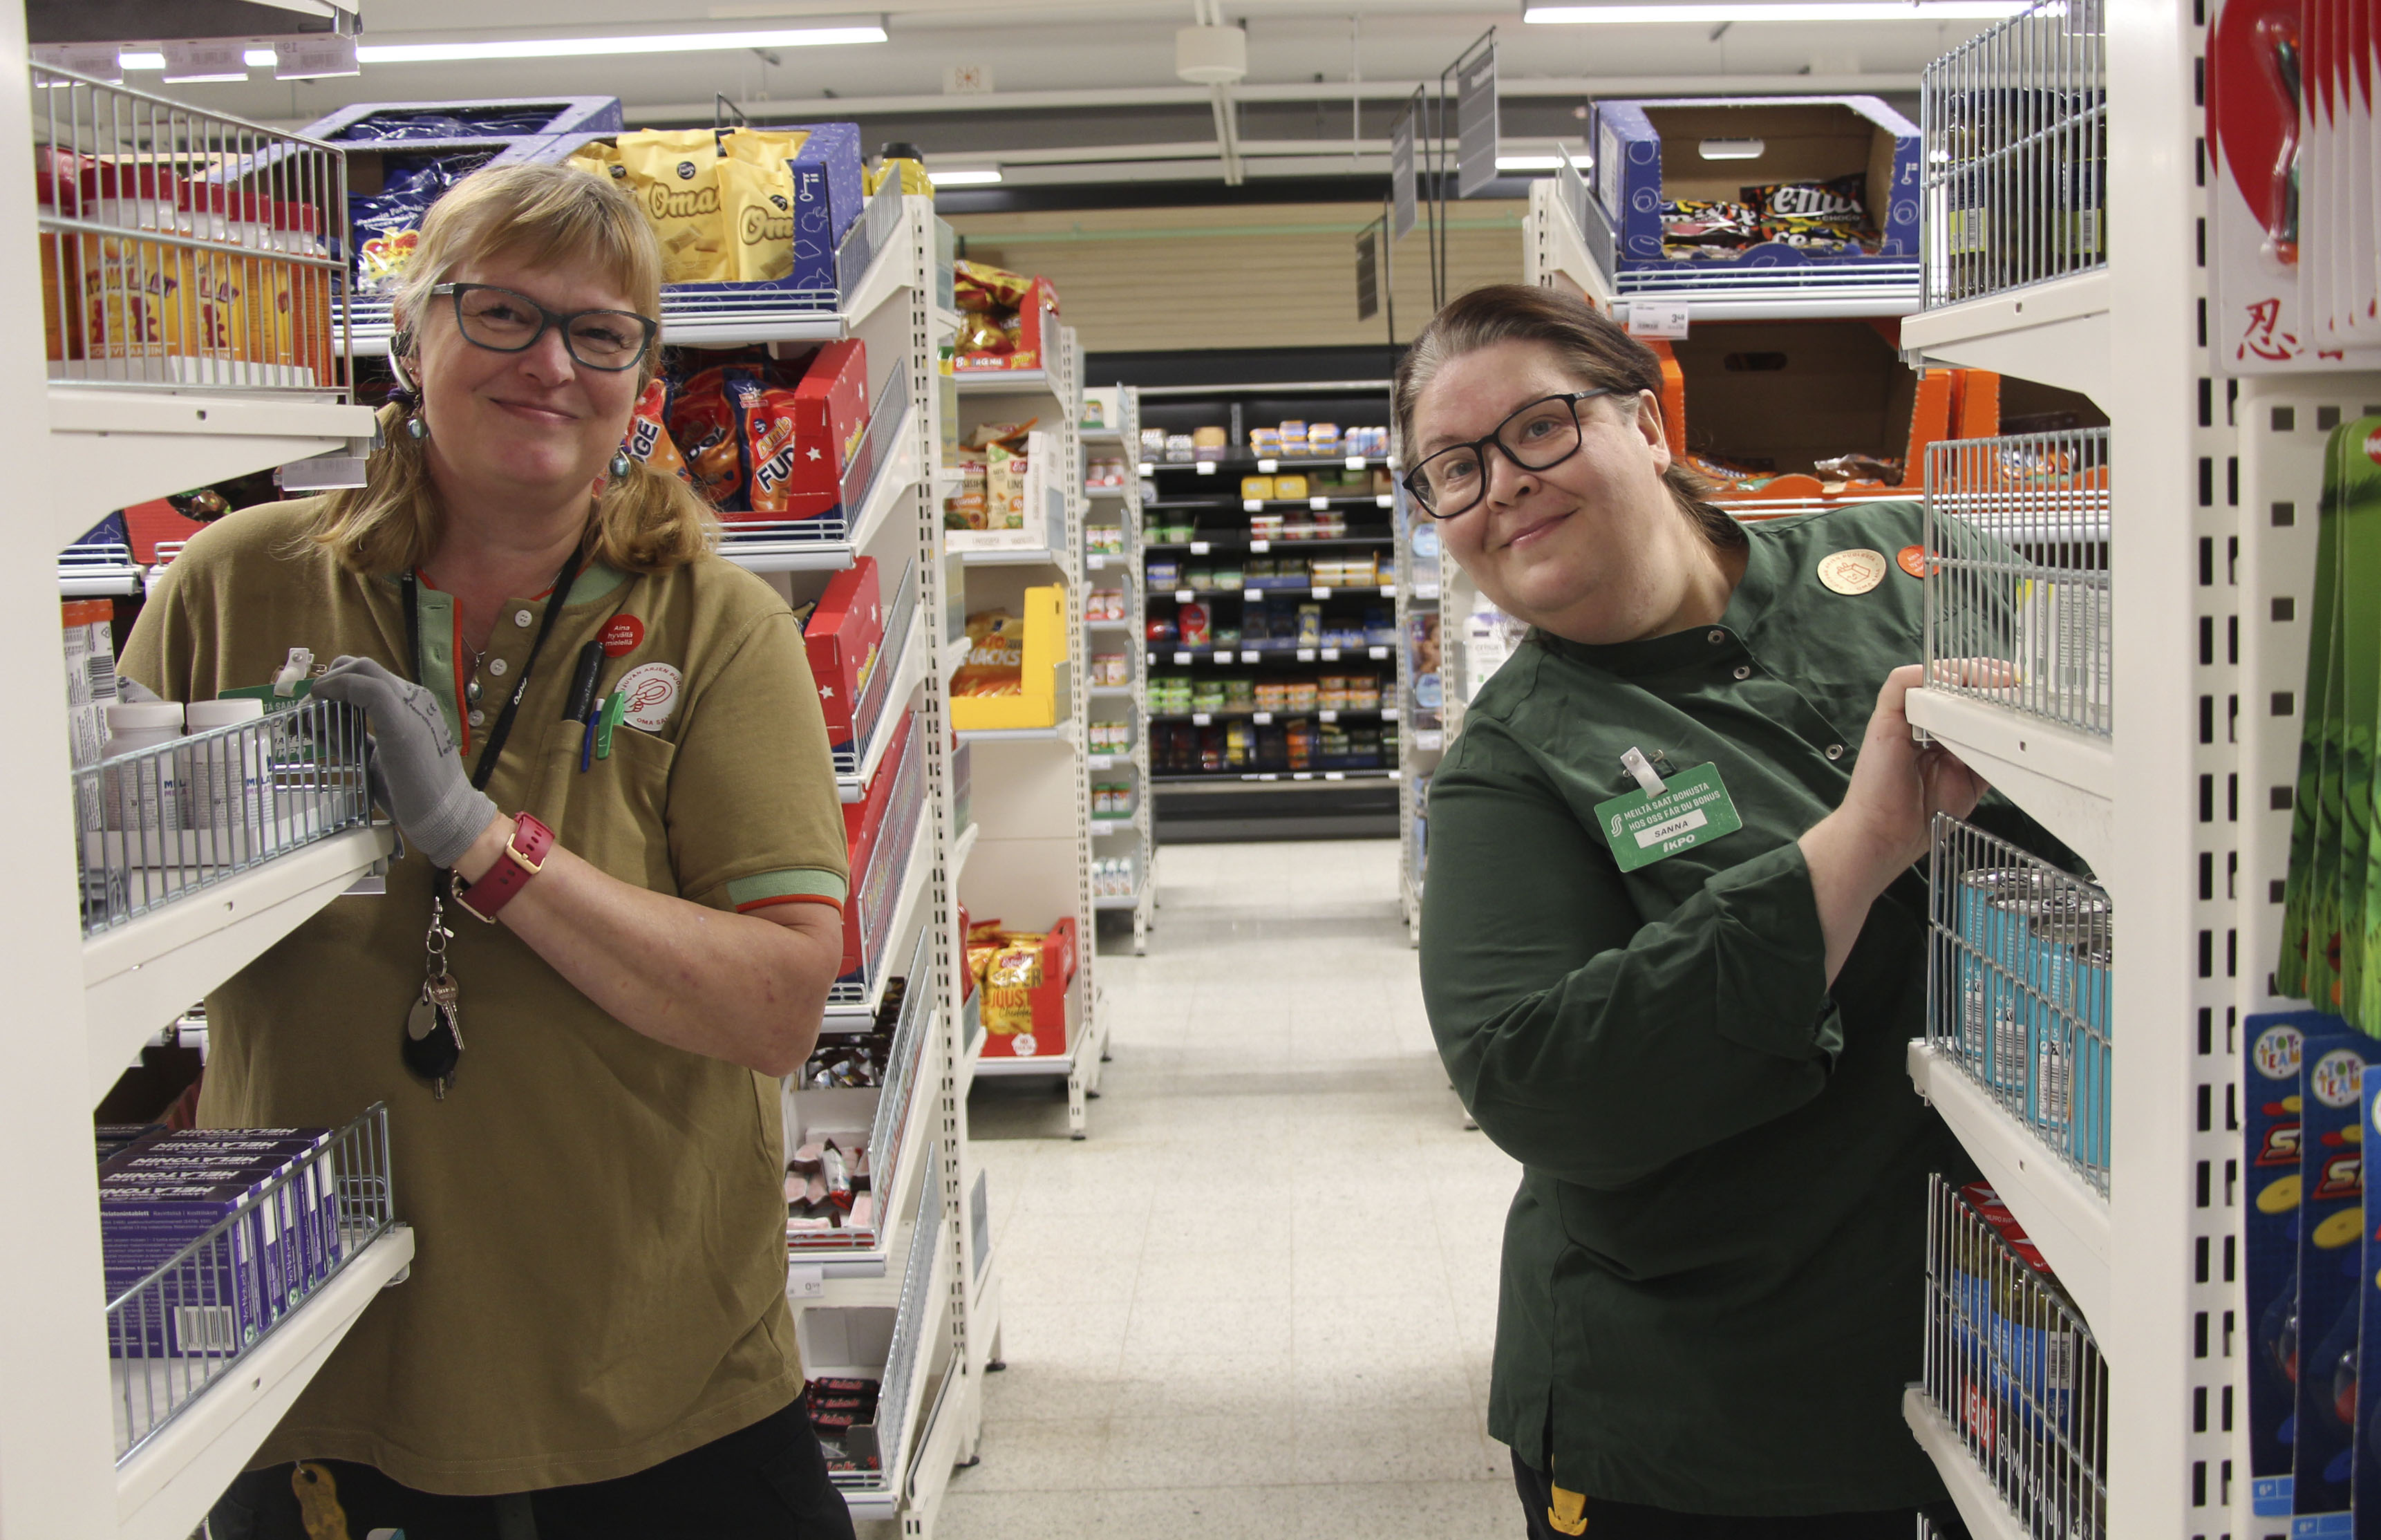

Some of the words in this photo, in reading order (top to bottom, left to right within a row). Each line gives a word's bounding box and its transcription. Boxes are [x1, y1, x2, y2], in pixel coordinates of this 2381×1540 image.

[2244, 298, 2297, 360] 忍
[608, 631, 633, 640] hyvällä
[275, 699, 296, 711] SAAT
[1624, 803, 1653, 820] MEILTÄ
[1652, 796, 1672, 811] SAAT
[1673, 782, 1710, 802] BONUSTA
[1628, 819, 1646, 832] HOS
[1646, 814, 1664, 827] OSS
[1664, 805, 1681, 820] FÅR
[1681, 802, 1693, 813] DU
[1693, 790, 1721, 807] BONUS
[1654, 820, 1689, 838] SANNA
[2259, 1047, 2301, 1069] TEAM
[2318, 1073, 2361, 1097] TEAM
[156, 1141, 279, 1149] MELATONIN
[133, 1156, 262, 1164] MELATONIN
[109, 1171, 240, 1181] MELATONIN
[1984, 1214, 2002, 1222] HELPPO
